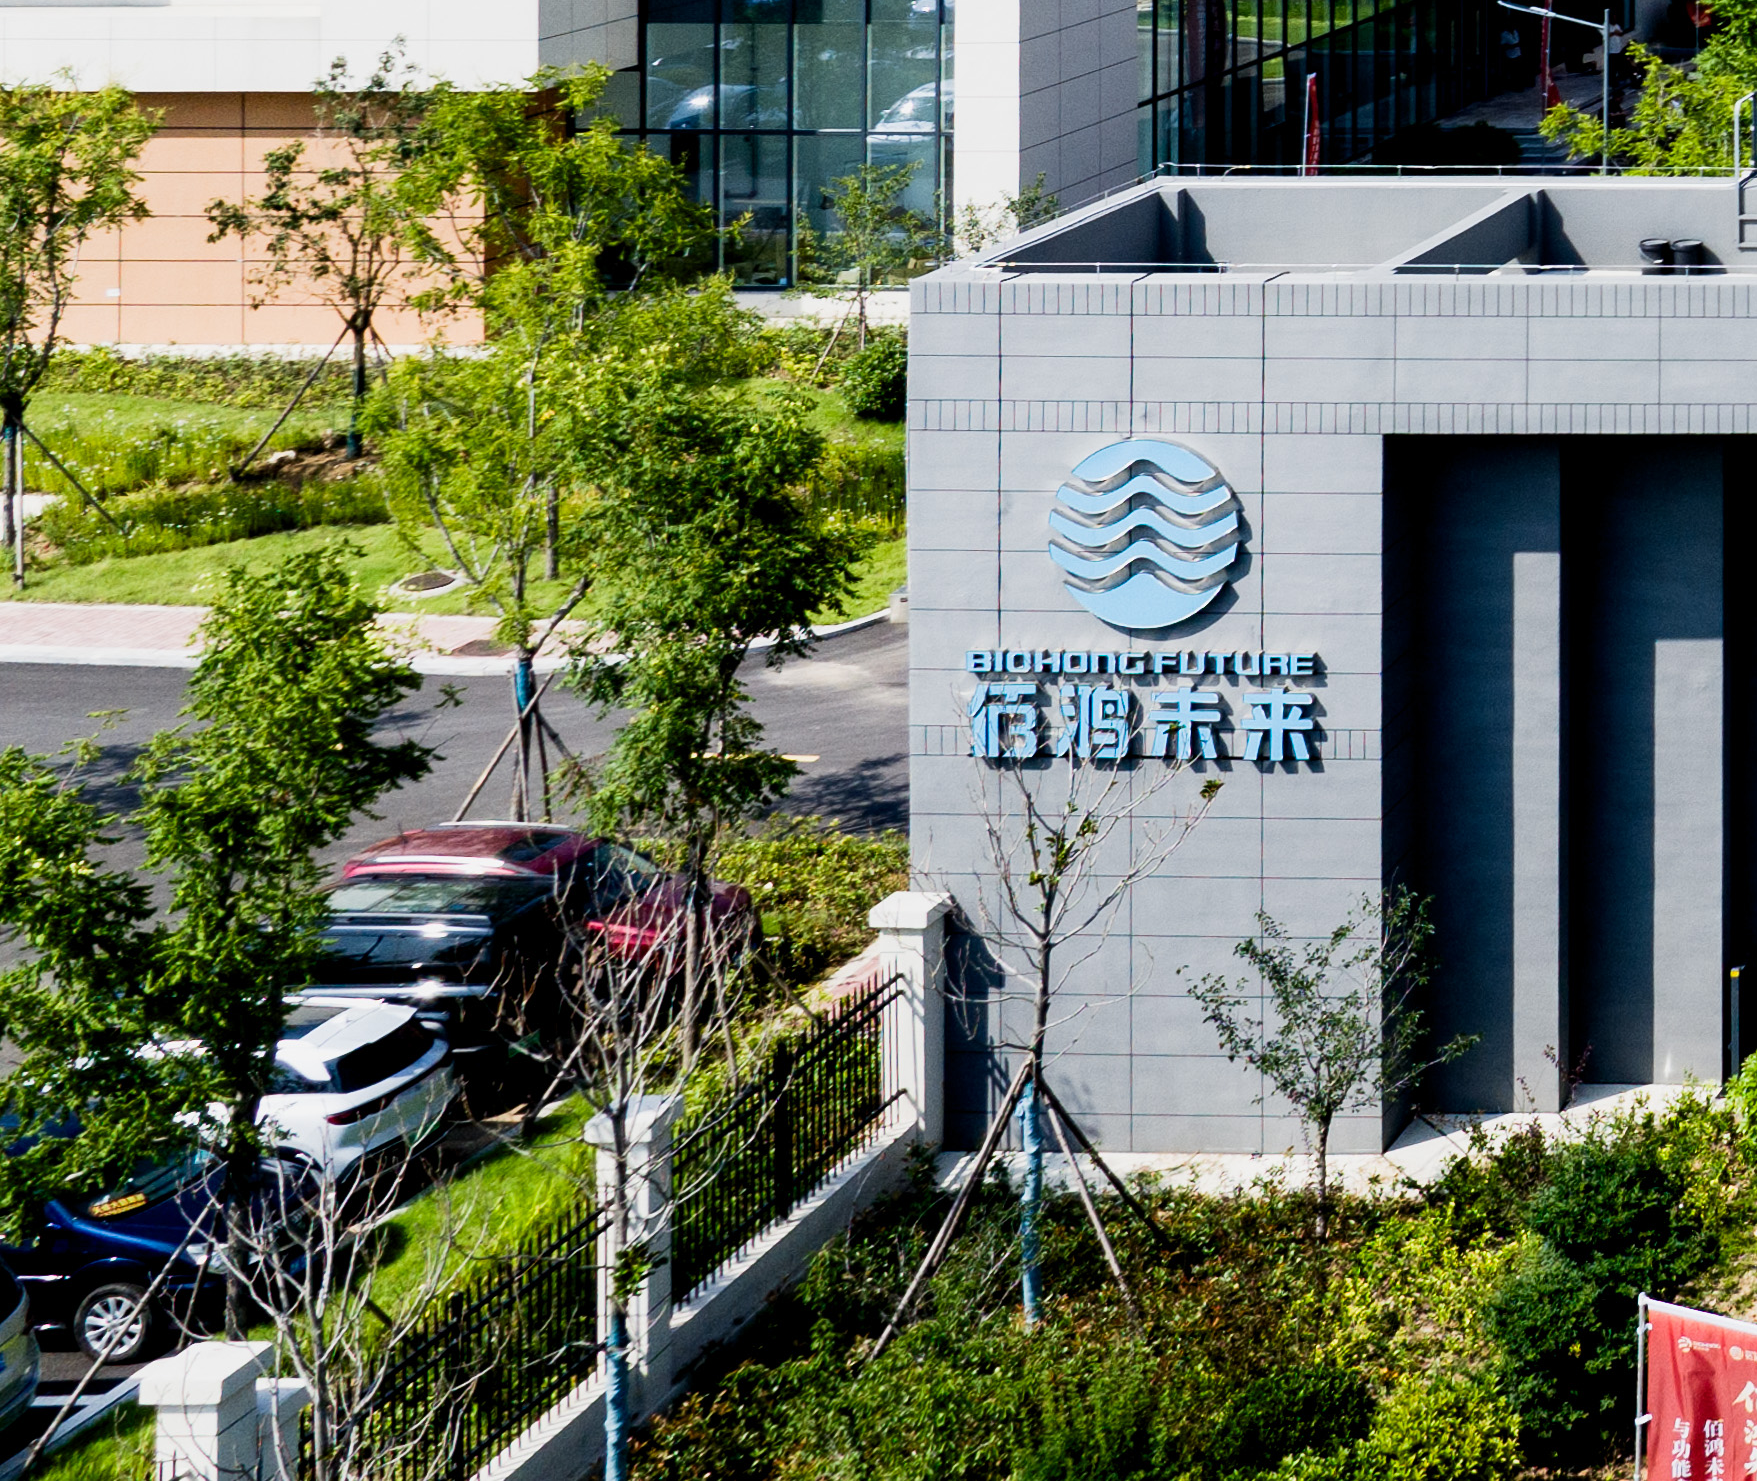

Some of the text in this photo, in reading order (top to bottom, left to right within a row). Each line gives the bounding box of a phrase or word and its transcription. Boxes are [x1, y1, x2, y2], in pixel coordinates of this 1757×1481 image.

[965, 650, 1316, 677] BIOHONG FUTURE
[967, 683, 1315, 762] 佰鸿未来
